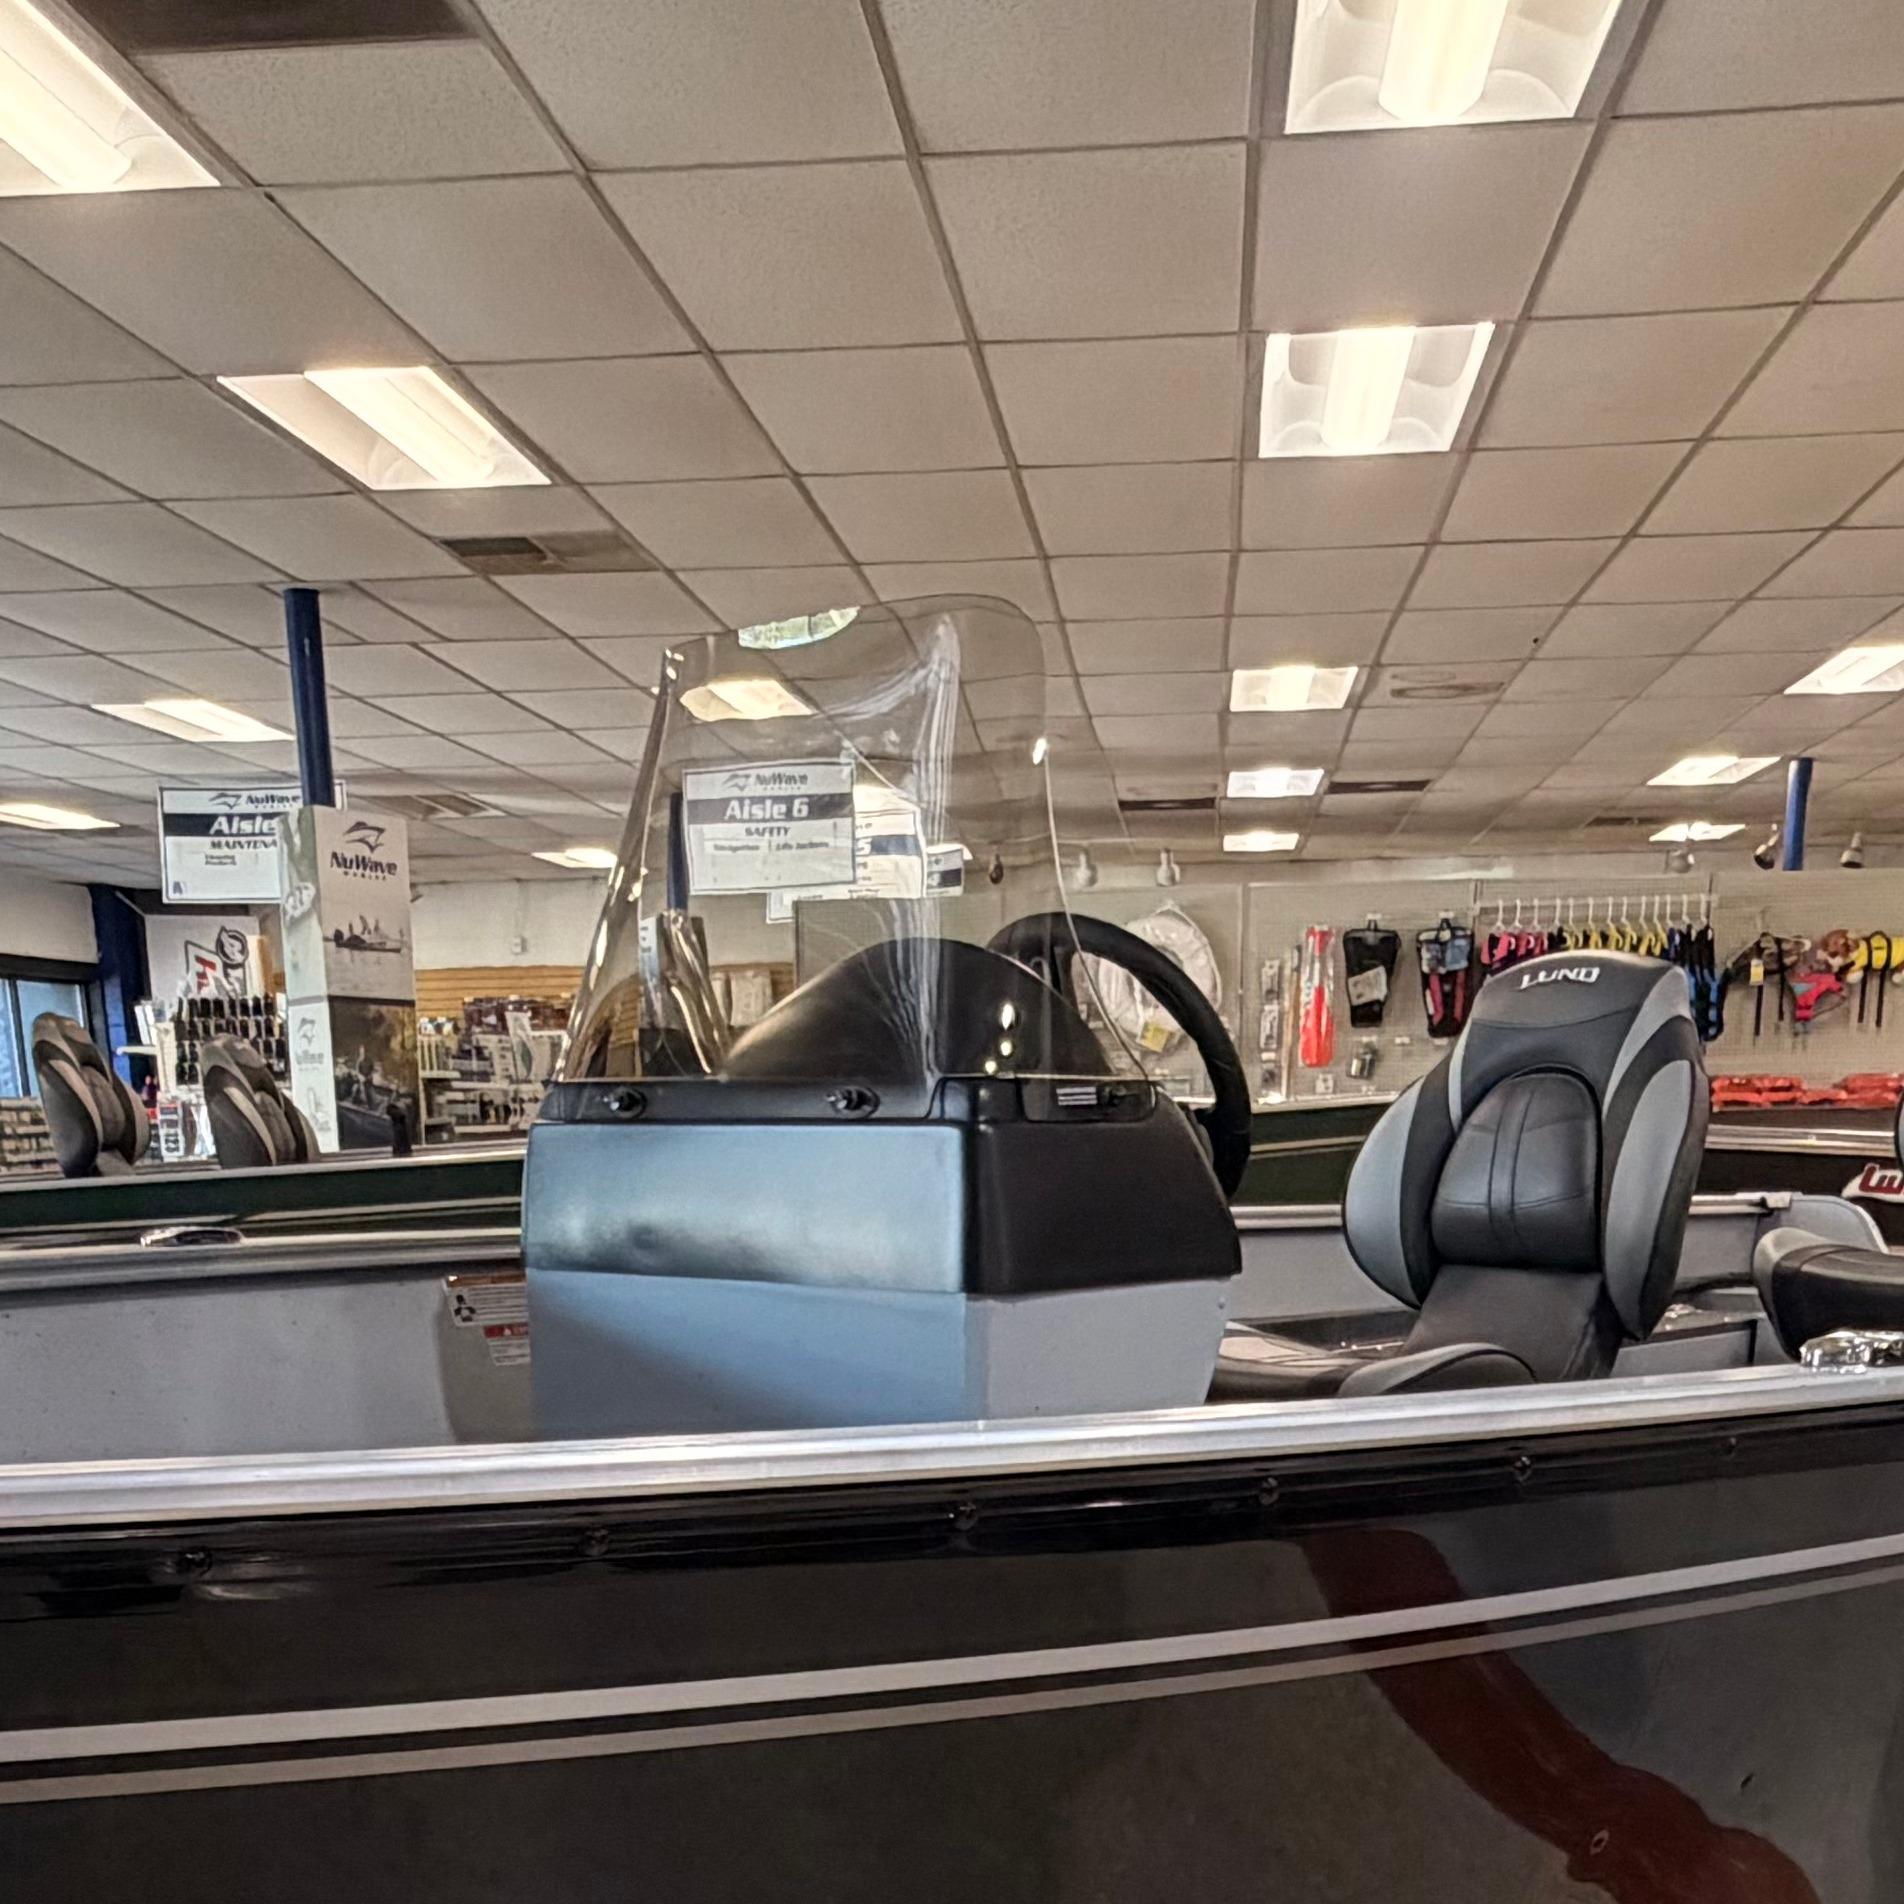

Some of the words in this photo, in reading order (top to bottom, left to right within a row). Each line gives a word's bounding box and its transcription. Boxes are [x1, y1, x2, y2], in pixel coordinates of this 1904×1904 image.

[723, 799, 788, 821] Aisle
[792, 797, 809, 818] 6
[209, 815, 278, 835] Aisle
[744, 825, 791, 837] SAFETY
[209, 839, 277, 850] MAINTENA
[330, 851, 398, 876] NuWave
[1520, 966, 1600, 990] LUND
